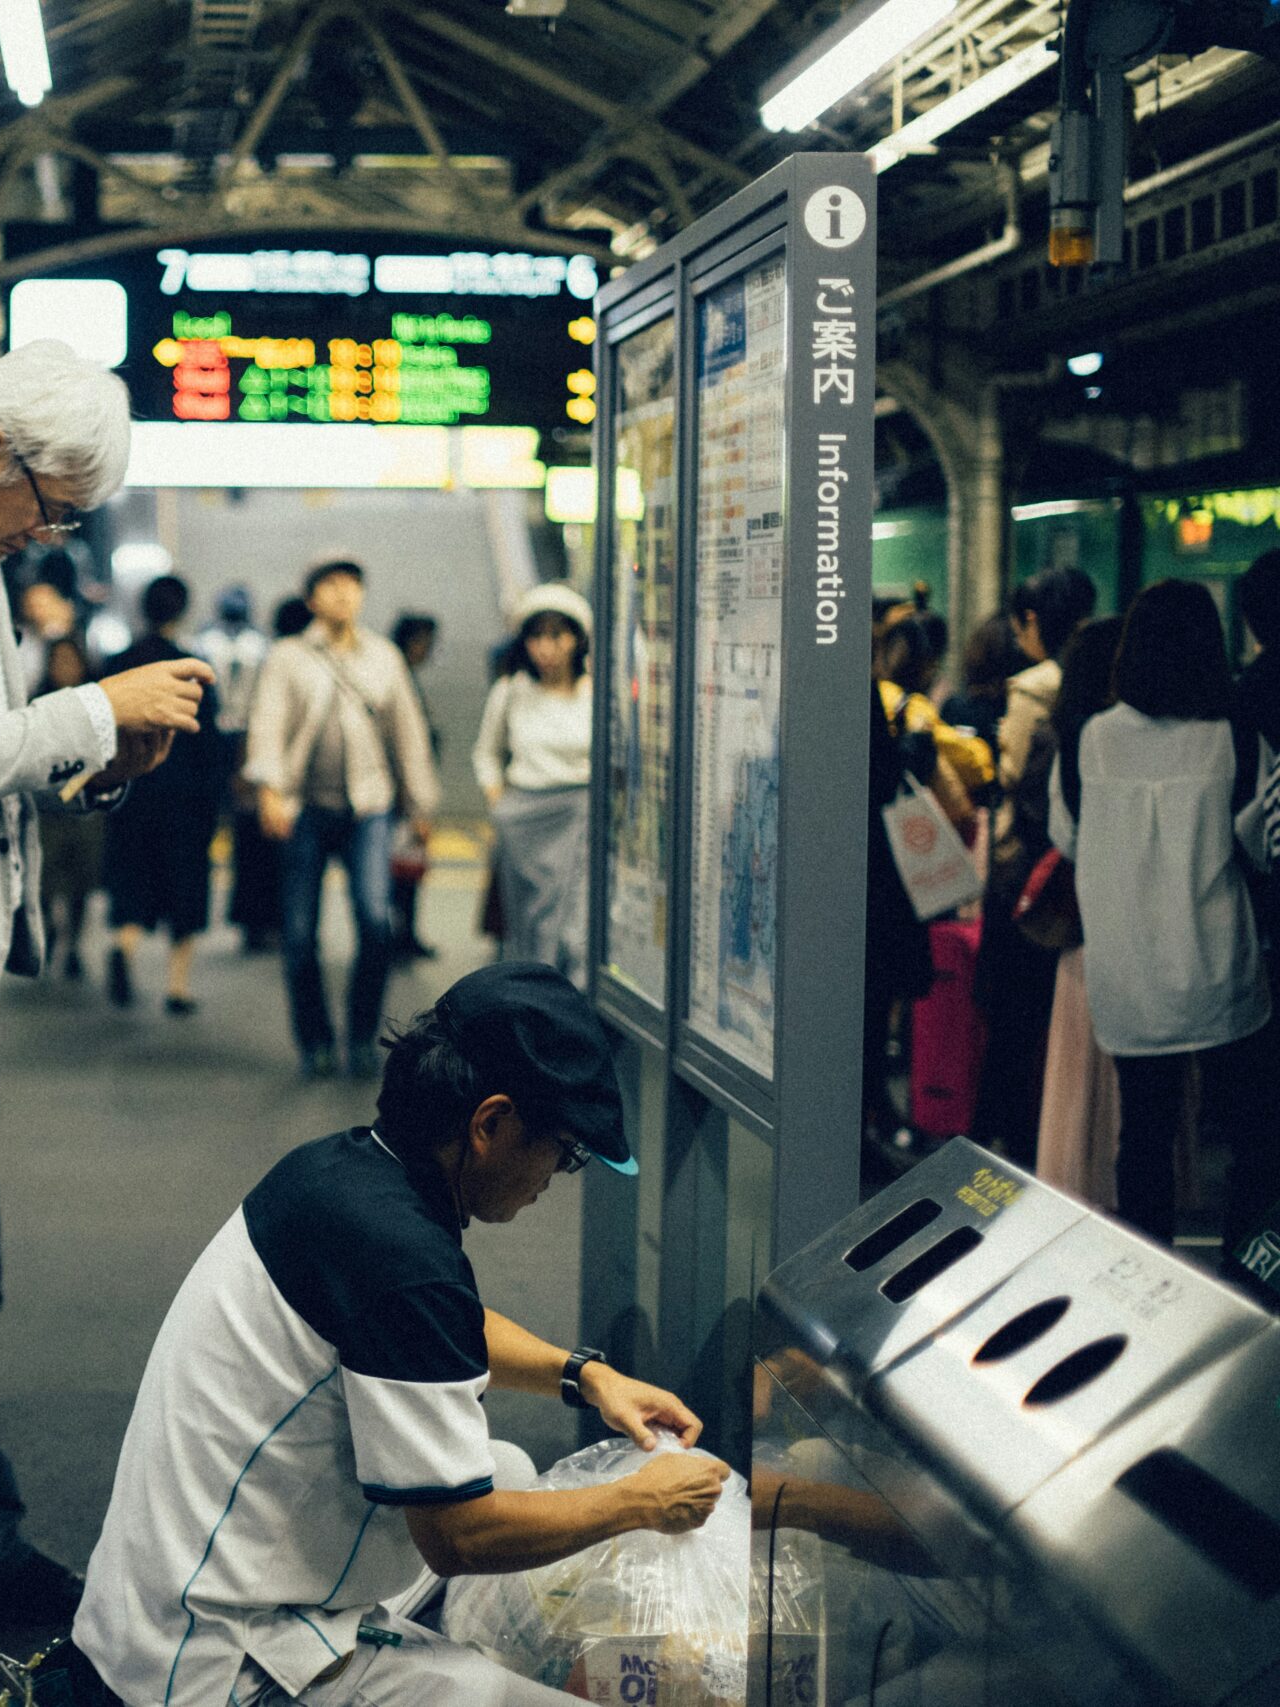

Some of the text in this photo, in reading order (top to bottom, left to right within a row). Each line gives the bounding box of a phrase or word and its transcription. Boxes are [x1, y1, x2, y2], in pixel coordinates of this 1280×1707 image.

[812, 277, 857, 405] ご案内
[815, 433, 849, 645] Information
